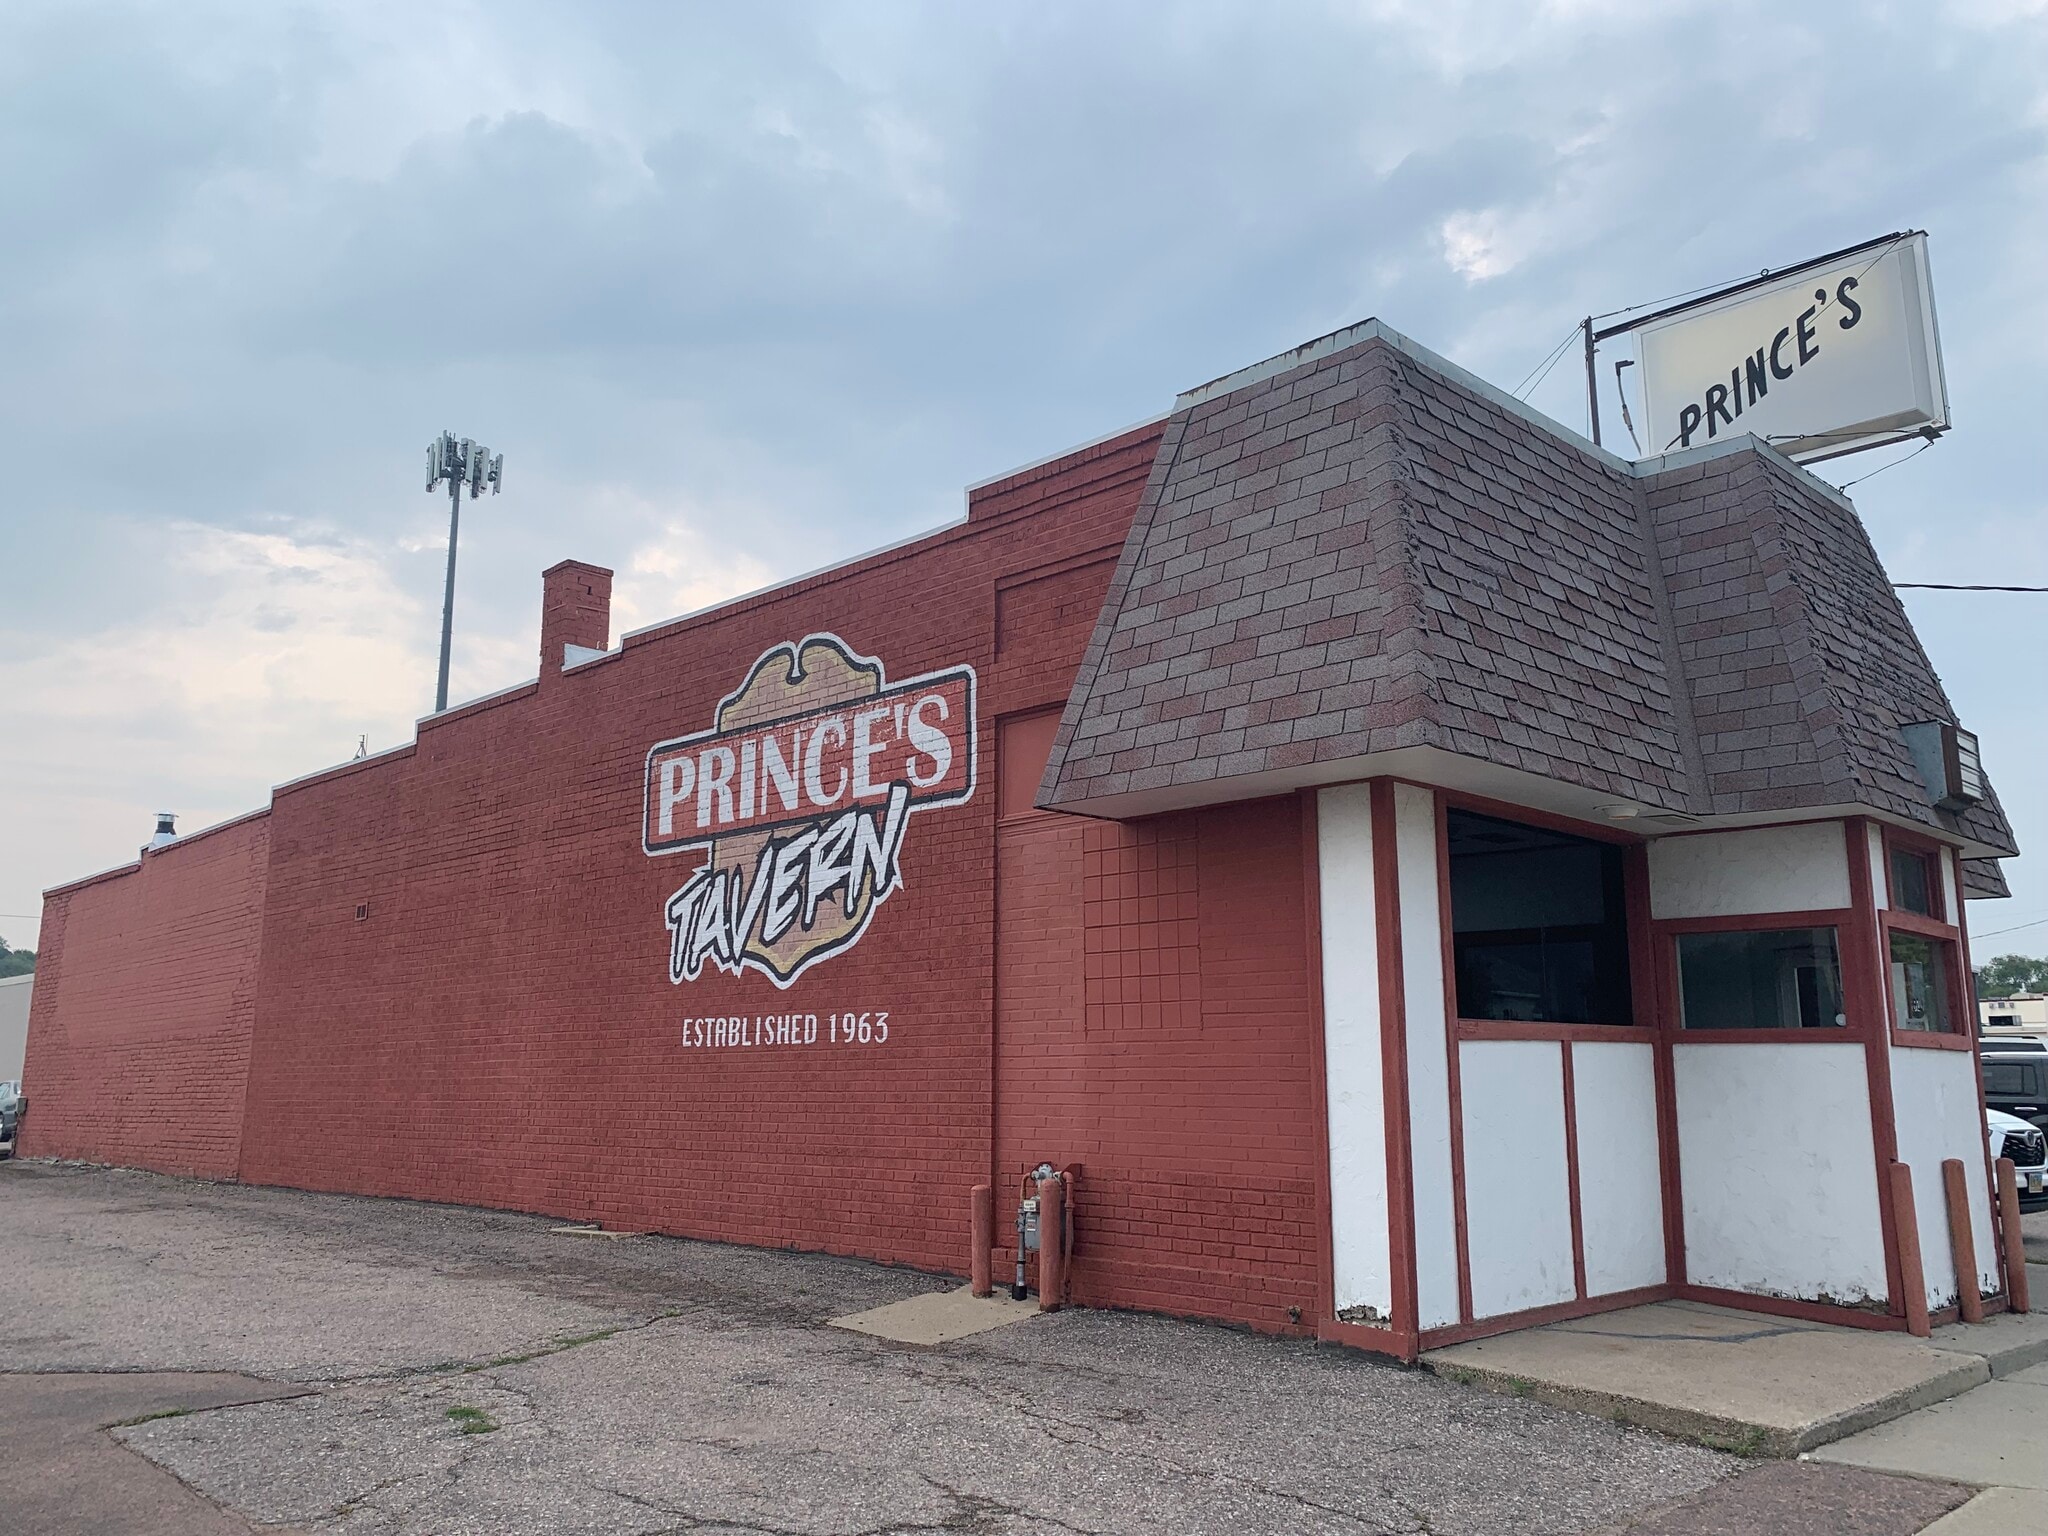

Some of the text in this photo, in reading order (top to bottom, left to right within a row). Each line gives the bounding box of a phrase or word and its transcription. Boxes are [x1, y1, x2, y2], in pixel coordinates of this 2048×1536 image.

[1679, 276, 1863, 448] PRINCE'S
[658, 694, 952, 836] PRINCE'S
[670, 786, 908, 976] TAVERN
[682, 1012, 889, 1047] ESTABLISHED 1963
